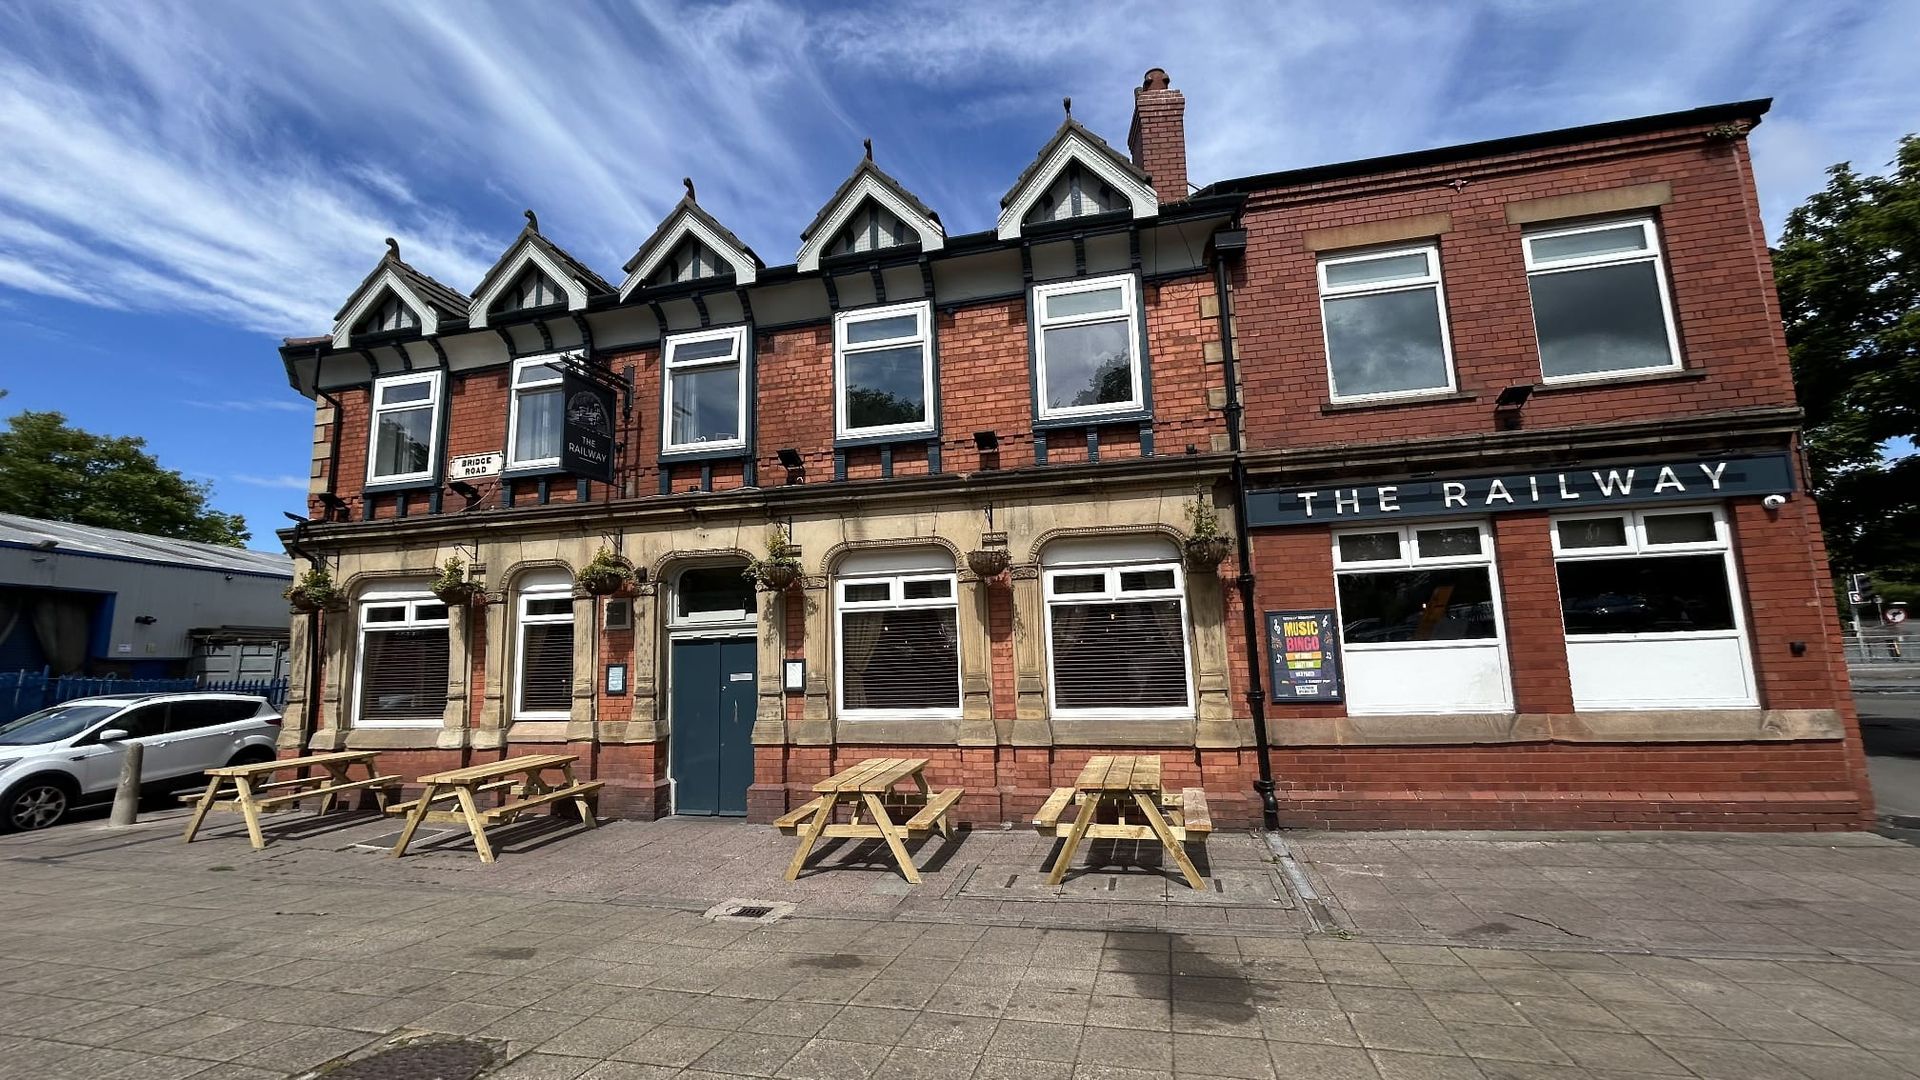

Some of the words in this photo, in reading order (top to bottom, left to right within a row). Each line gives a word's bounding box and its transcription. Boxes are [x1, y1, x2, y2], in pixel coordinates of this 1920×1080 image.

[581, 436, 596, 448] THE
[568, 442, 607, 462] RAILWAY
[461, 456, 492, 467] BRIDGE
[465, 466, 487, 475] ROAD
[1297, 486, 1400, 517] THE
[1443, 462, 1727, 508] RAILWAY
[1283, 620, 1319, 637] MUSIC
[1286, 635, 1320, 652] BINGO
